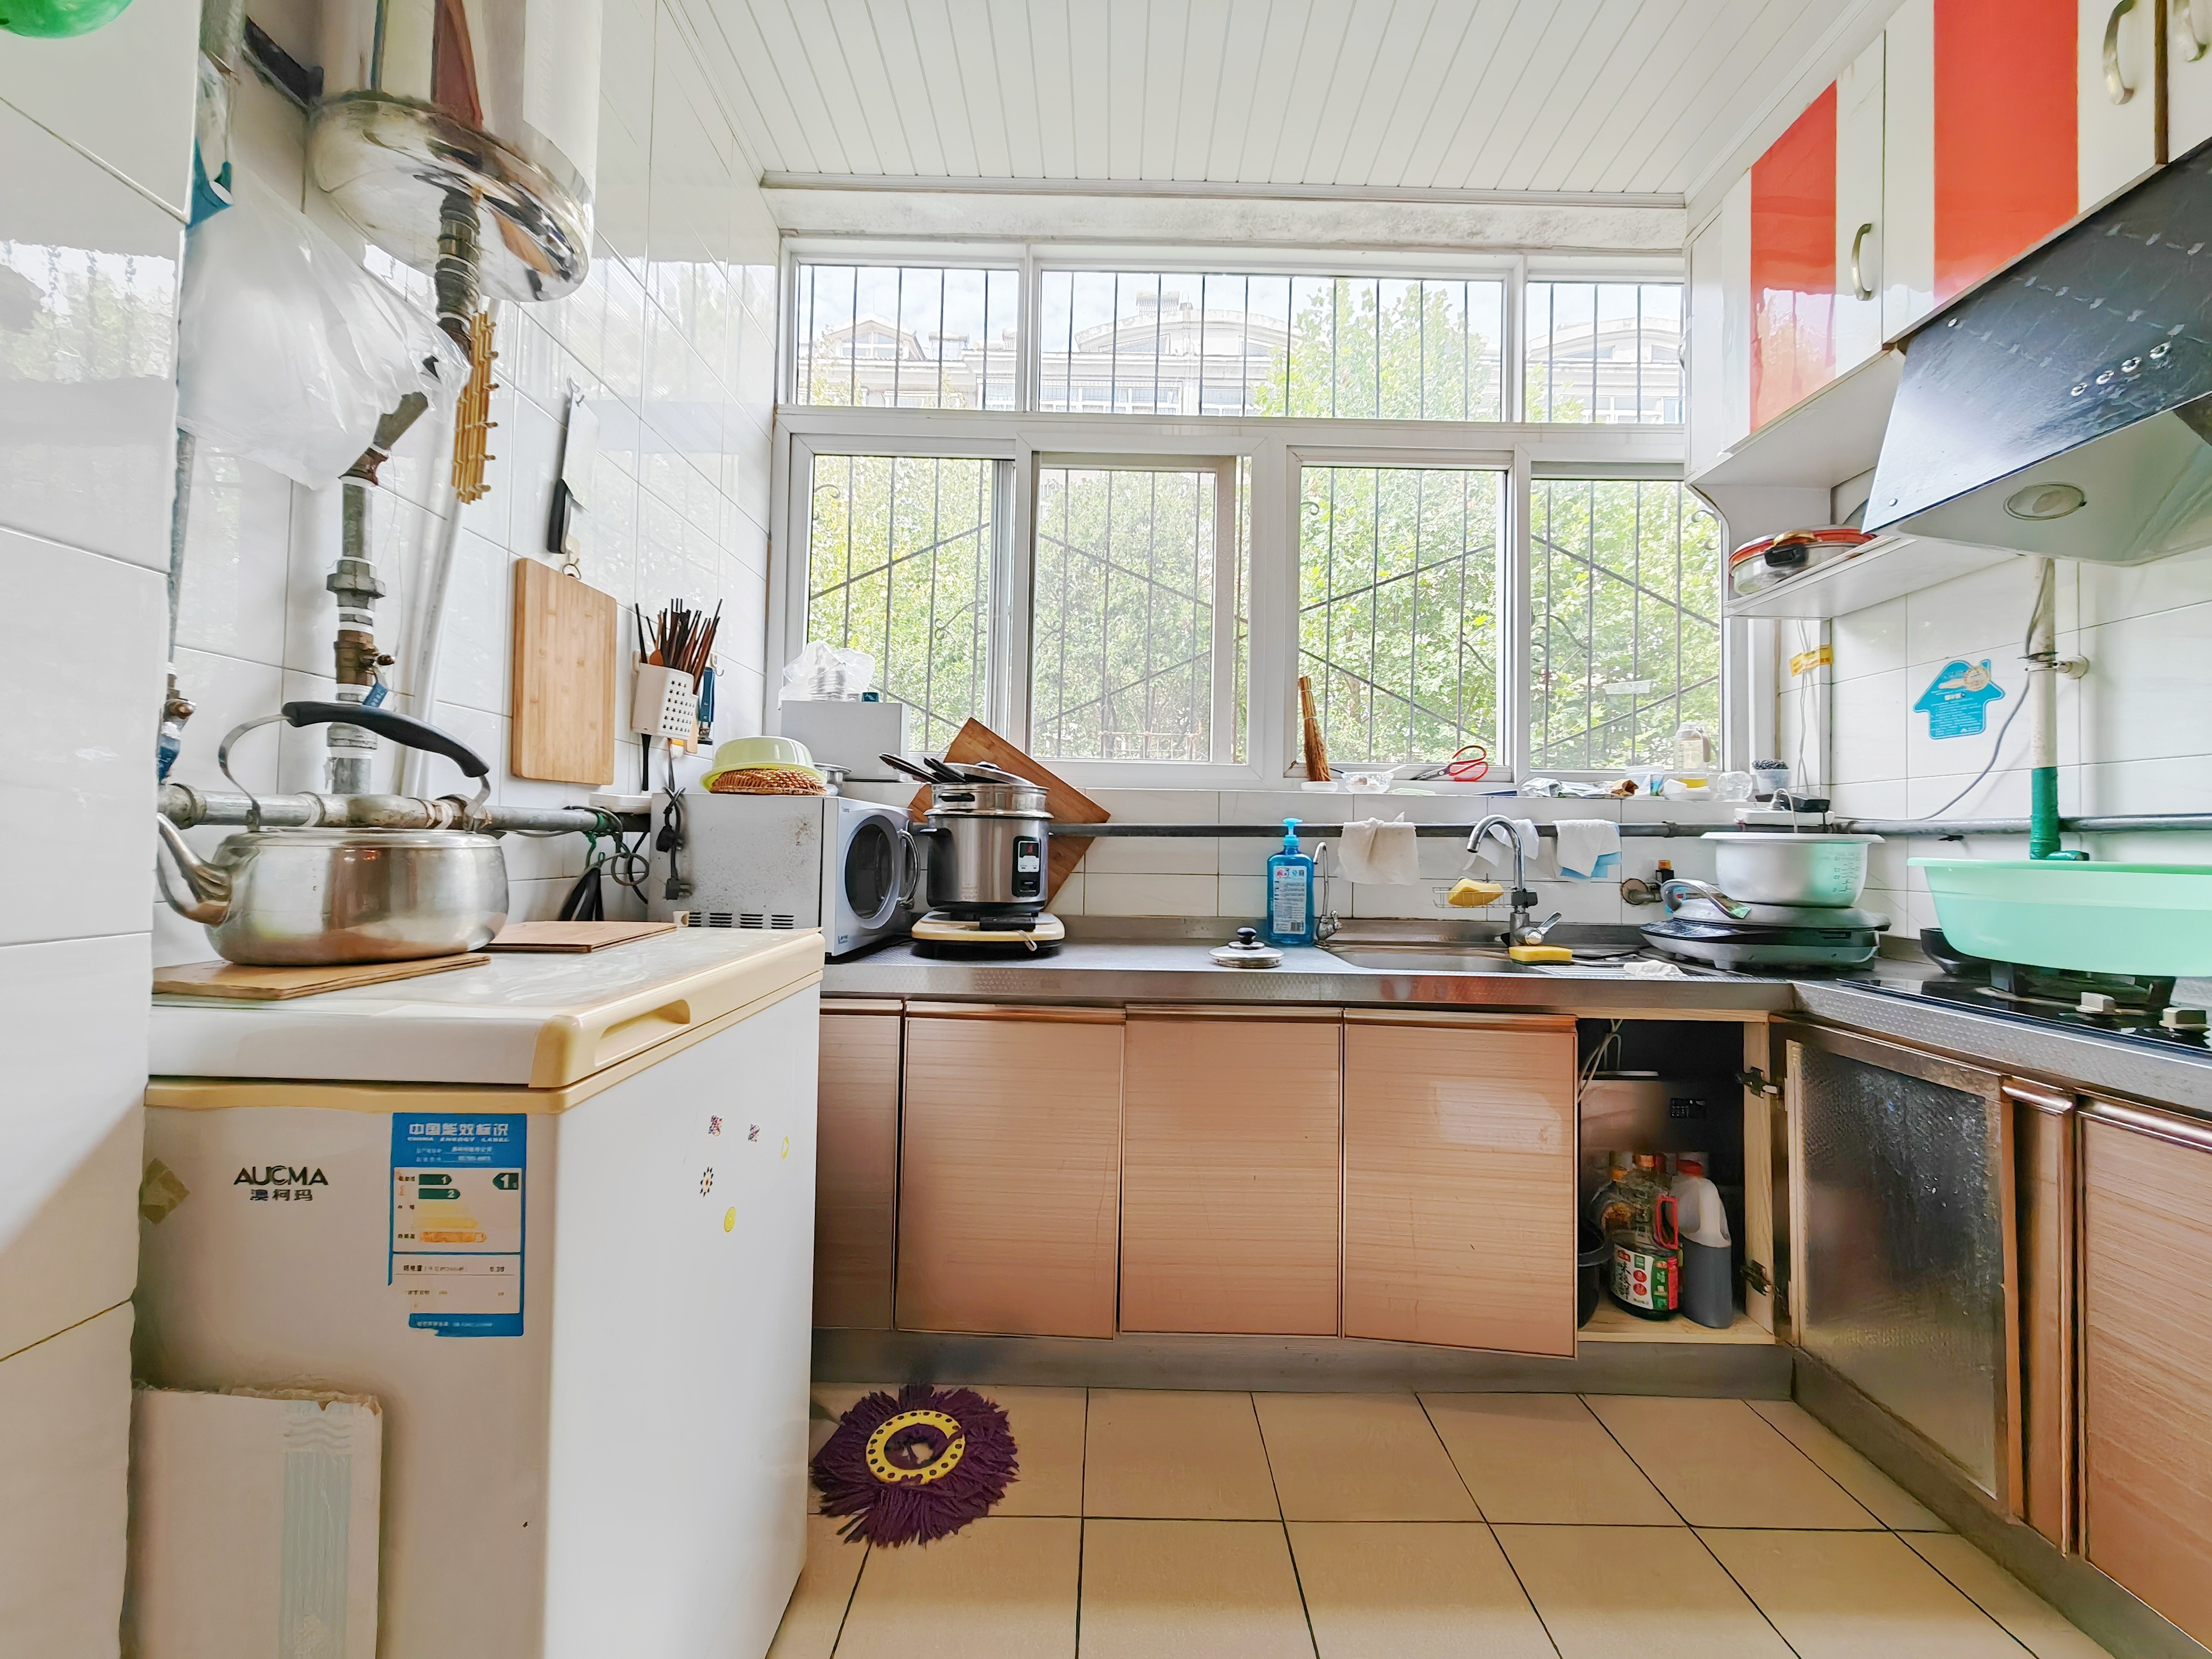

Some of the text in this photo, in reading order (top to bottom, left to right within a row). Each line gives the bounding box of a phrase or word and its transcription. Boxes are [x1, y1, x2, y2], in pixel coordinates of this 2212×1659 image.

[409, 1123, 509, 1136] 中国能效标识
[233, 1165, 329, 1185] AUCMA
[441, 1176, 447, 1184] 1
[249, 1189, 313, 1201] 澳柯玛
[447, 1190, 455, 1198] 2
